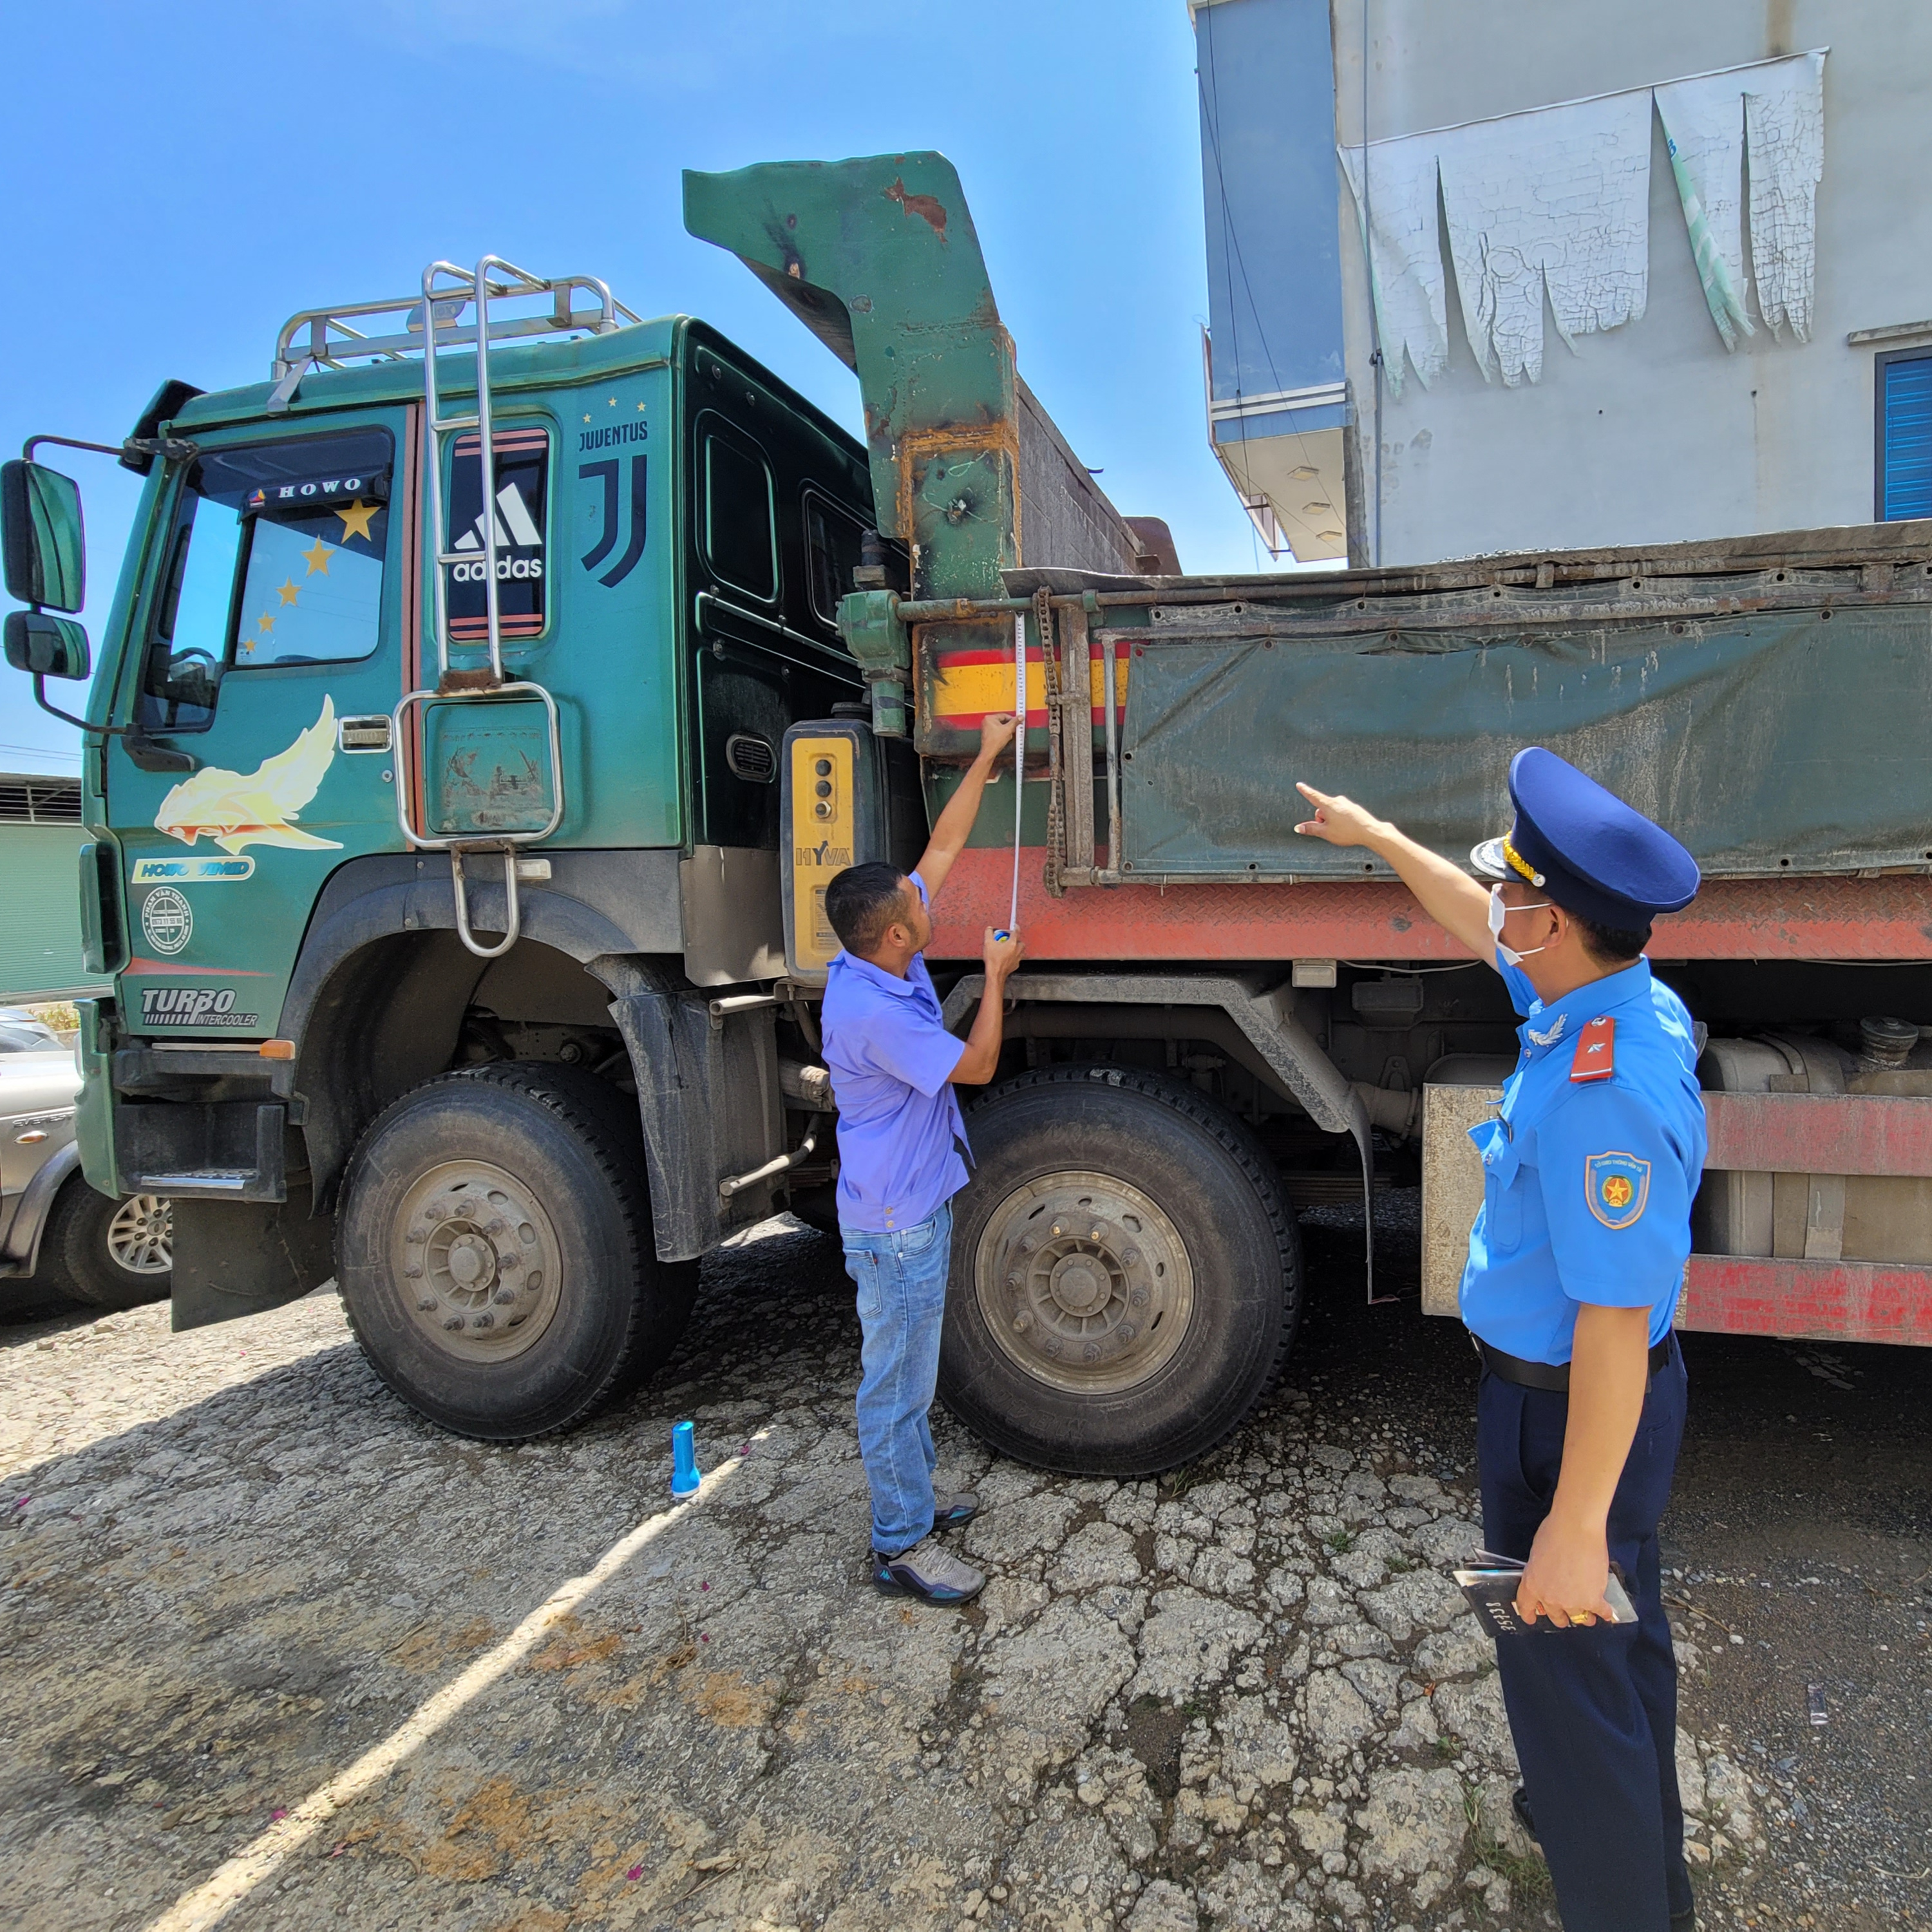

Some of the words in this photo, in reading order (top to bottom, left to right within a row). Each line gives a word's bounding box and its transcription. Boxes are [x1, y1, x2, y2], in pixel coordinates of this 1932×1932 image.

[579, 421, 648, 452] JUVENTUS
[278, 478, 361, 498] HOWO
[453, 555, 542, 582] addas
[795, 840, 851, 866] HYVA
[142, 989, 236, 1020] TURBO
[195, 1014, 258, 1025] INTERCOOLER
